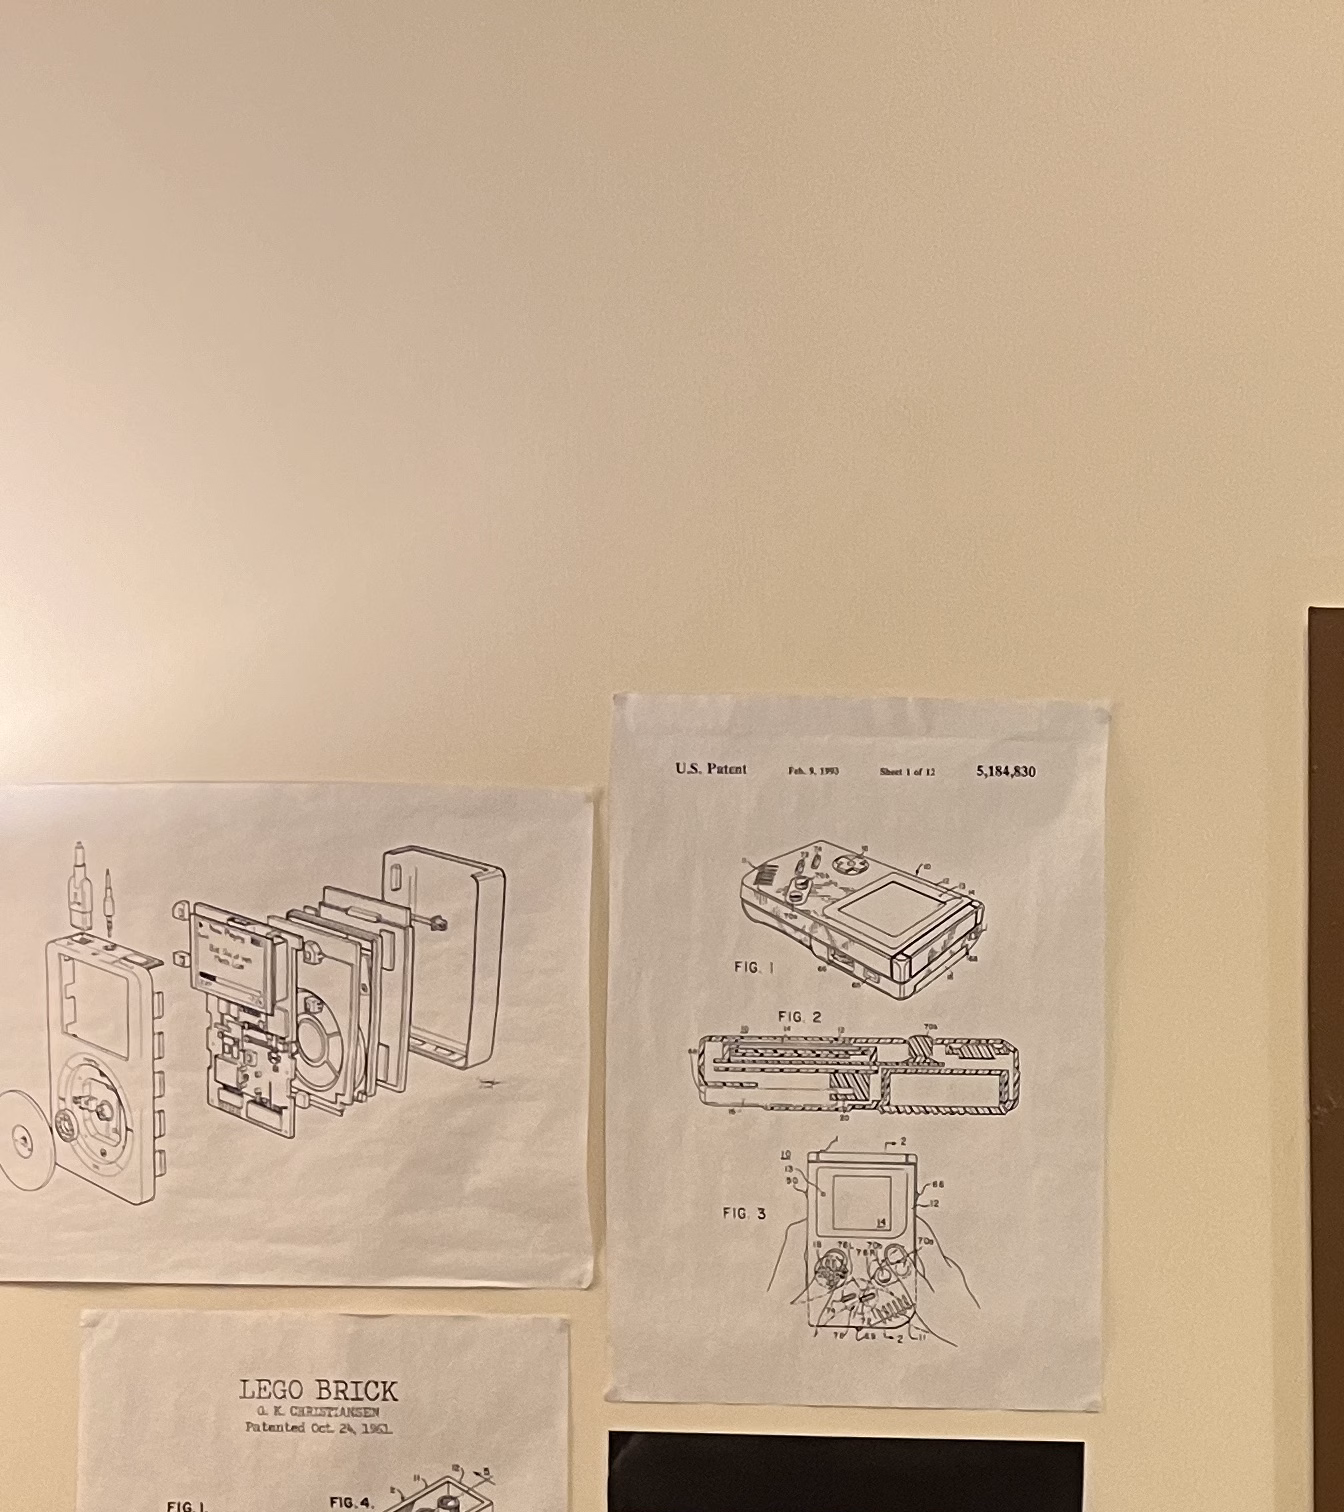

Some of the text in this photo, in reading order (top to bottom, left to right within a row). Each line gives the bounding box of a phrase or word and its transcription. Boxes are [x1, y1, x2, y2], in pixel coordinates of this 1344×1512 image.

[676, 763, 747, 774] U.S. Patent
[879, 767, 935, 776] Sheet 1 of 12
[976, 766, 1036, 779] 5,184,830
[735, 961, 762, 974] FIG.
[779, 1012, 822, 1023] FIG. 2
[723, 1208, 766, 1220] FIG. 3
[239, 1379, 399, 1401] LEGO BRICK
[245, 1422, 305, 1433] Patented
